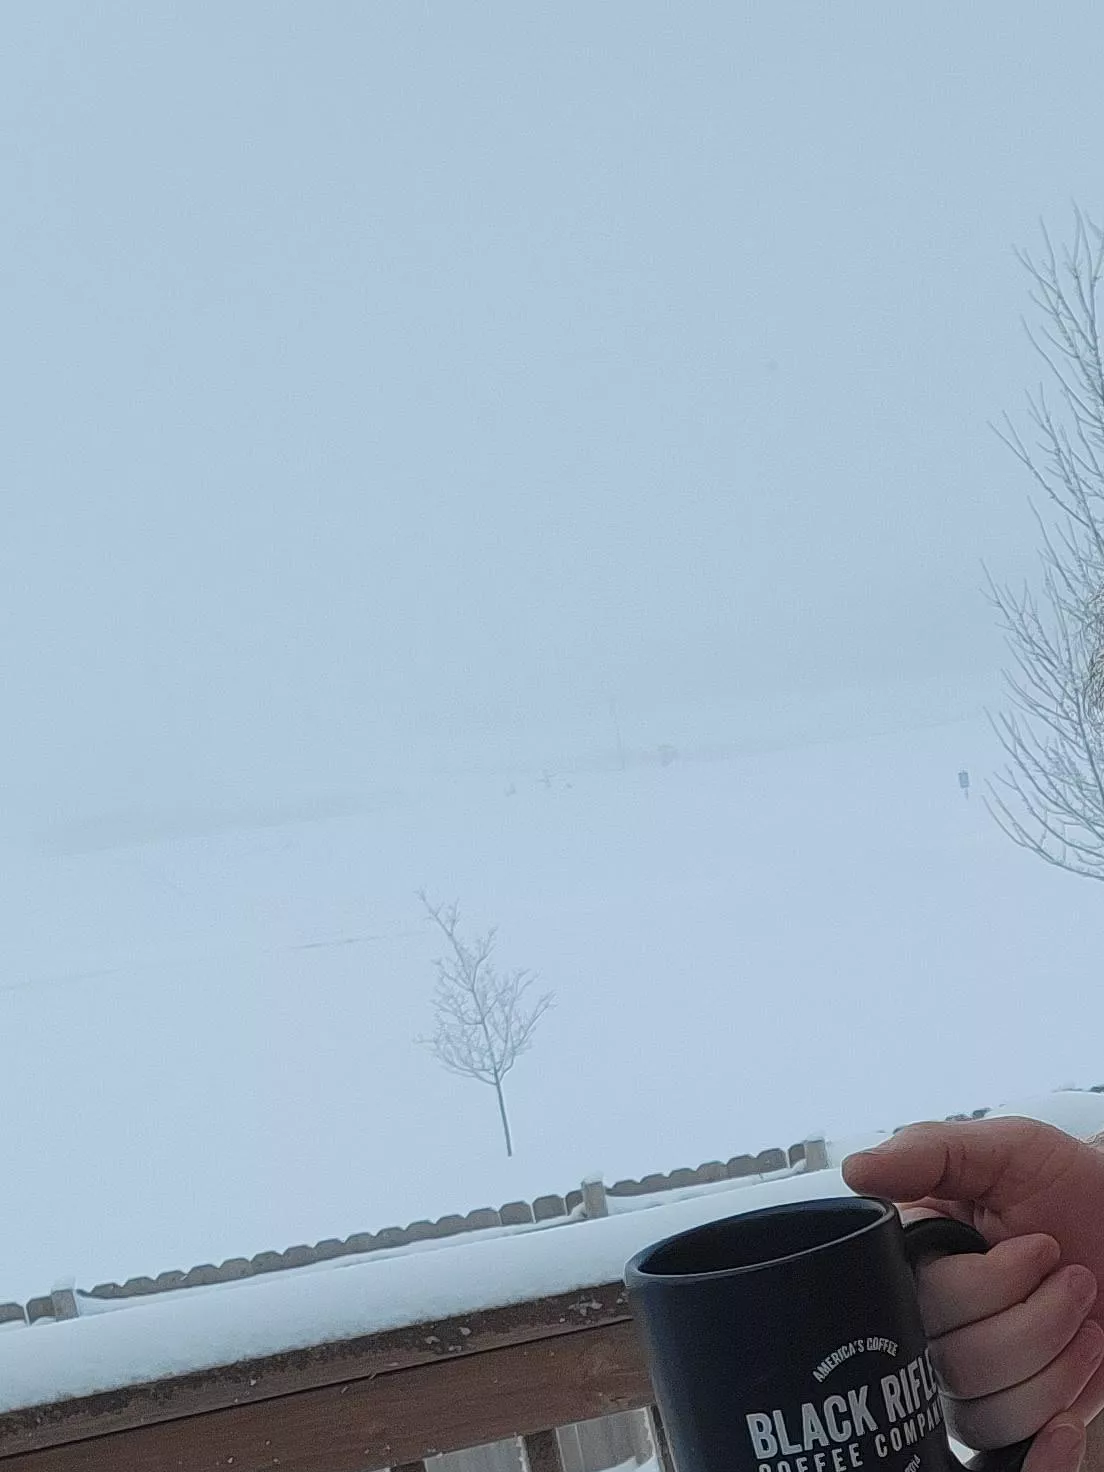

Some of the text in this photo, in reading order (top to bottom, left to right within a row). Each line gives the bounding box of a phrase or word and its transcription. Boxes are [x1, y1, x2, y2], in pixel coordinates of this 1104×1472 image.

[812, 1336, 899, 1383] AMERICA'S COFFEE
[746, 1385, 879, 1460] BLACK
